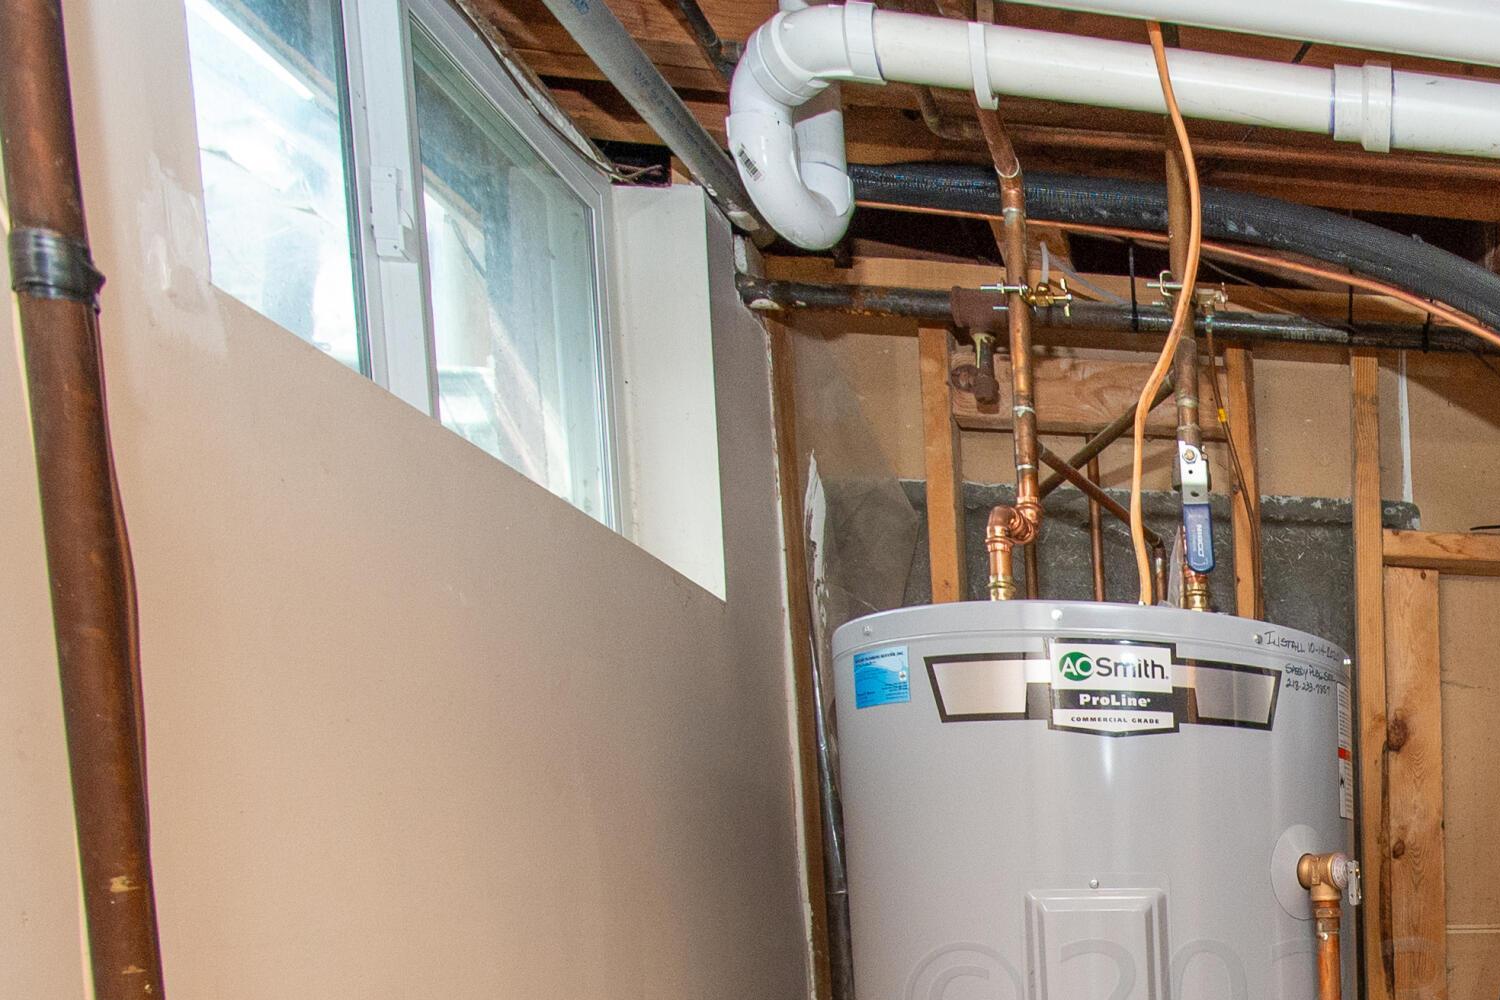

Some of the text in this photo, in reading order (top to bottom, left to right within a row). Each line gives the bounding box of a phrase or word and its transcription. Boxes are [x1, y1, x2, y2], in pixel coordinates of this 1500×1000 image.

[1060, 654, 1166, 680] AO Smith
[1079, 693, 1148, 707] ProLine
